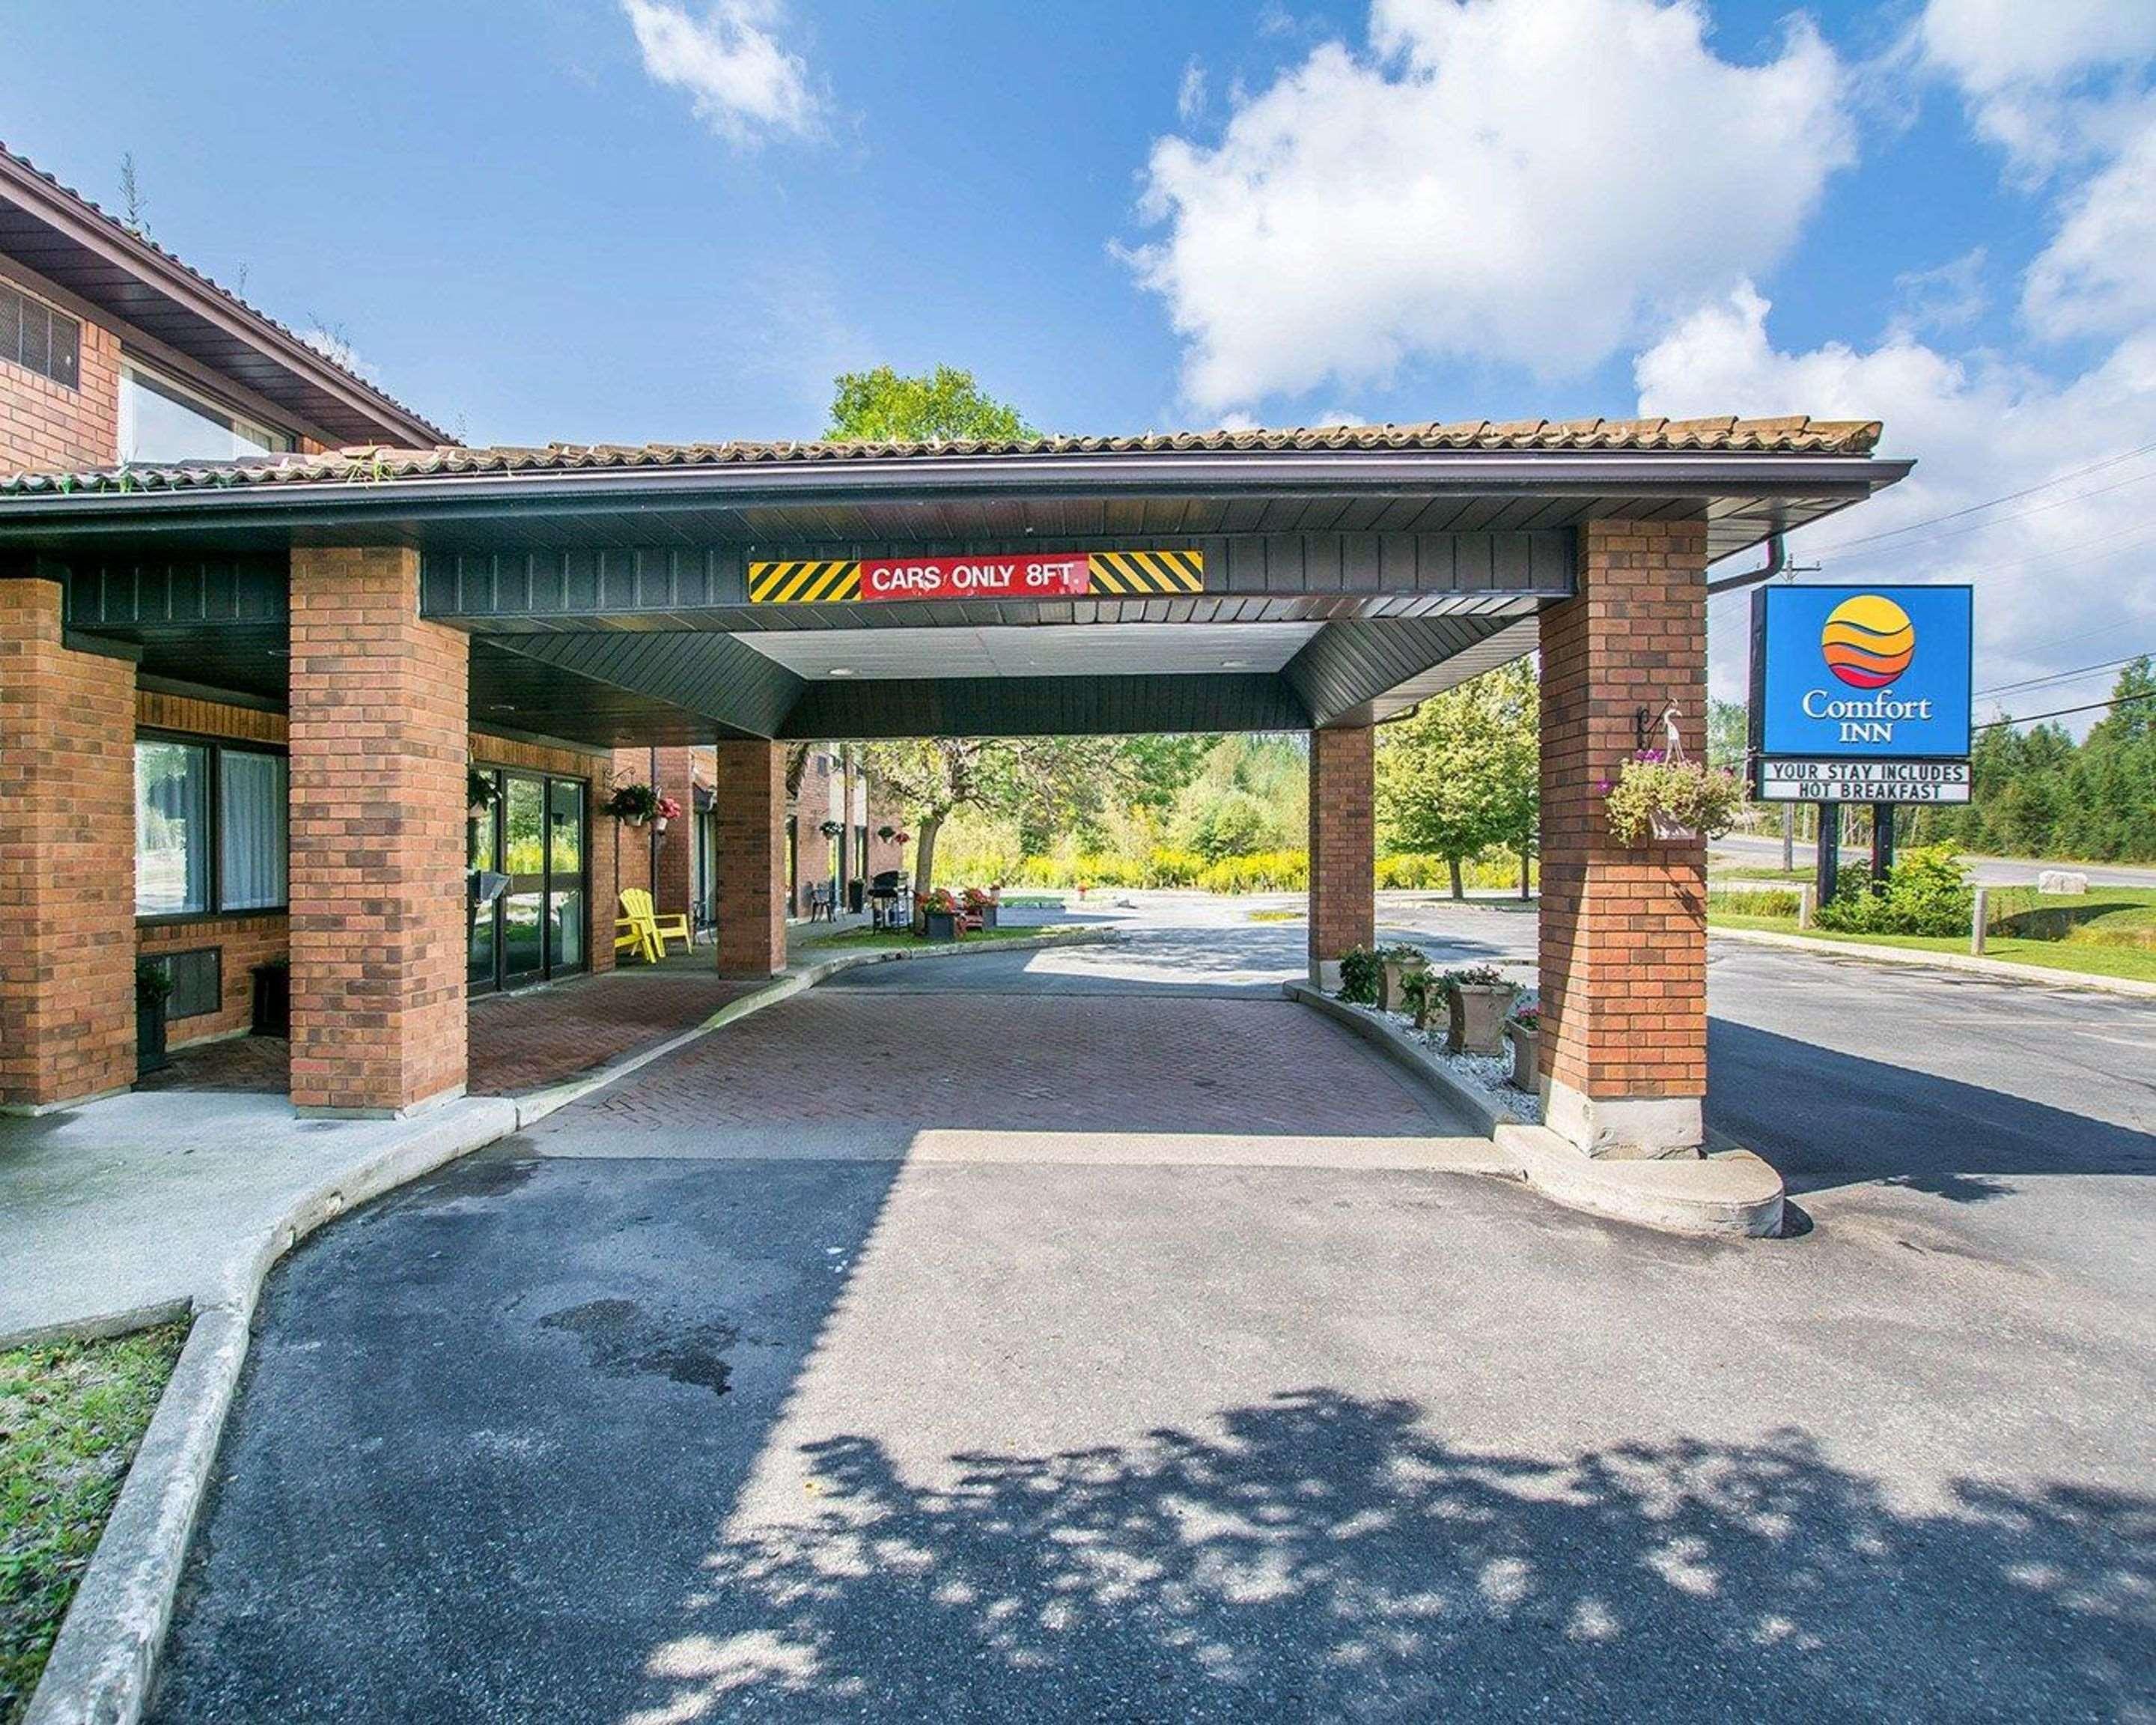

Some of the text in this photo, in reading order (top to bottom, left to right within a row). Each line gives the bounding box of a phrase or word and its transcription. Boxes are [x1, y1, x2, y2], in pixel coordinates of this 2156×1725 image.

[871, 567, 942, 590] CARS
[952, 564, 1015, 588] ONLY
[1802, 690, 1932, 719] Comfort
[1839, 722, 1892, 743] INN
[1773, 764, 1963, 781] YOUR STAY INCLUDES
[1800, 783, 1941, 798] HOT BREAKFAST
